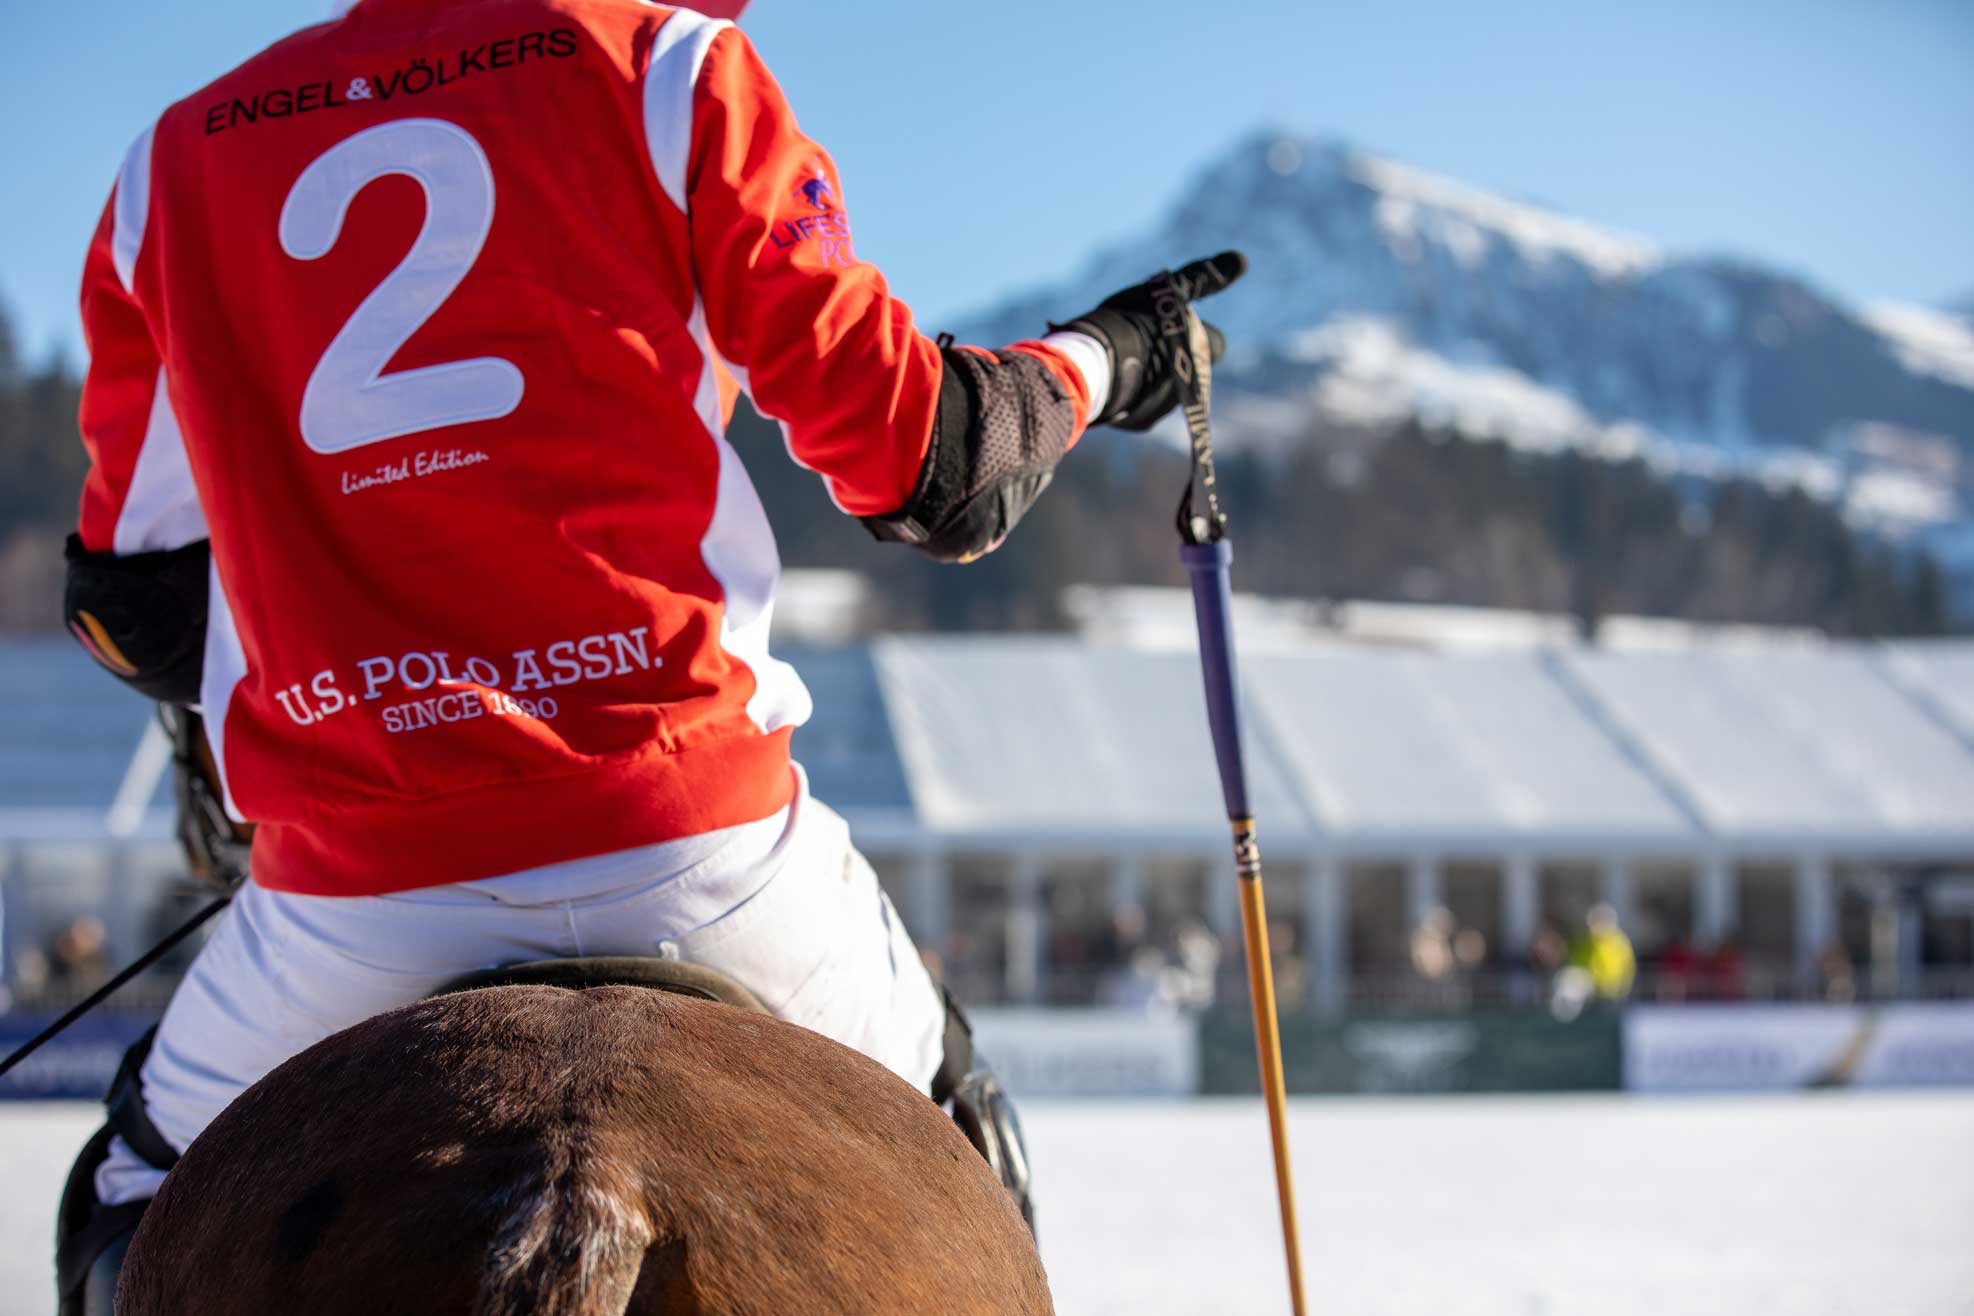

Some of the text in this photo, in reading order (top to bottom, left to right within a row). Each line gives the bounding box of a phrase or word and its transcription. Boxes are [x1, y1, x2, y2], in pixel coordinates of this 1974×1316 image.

[204, 29, 578, 136] ENGEL&VÖLKERS
[278, 117, 524, 455] 2
[341, 450, 490, 495] Limited Edition
[275, 626, 664, 726] U.S. POLO ASSN.
[381, 690, 483, 734] SINCE
